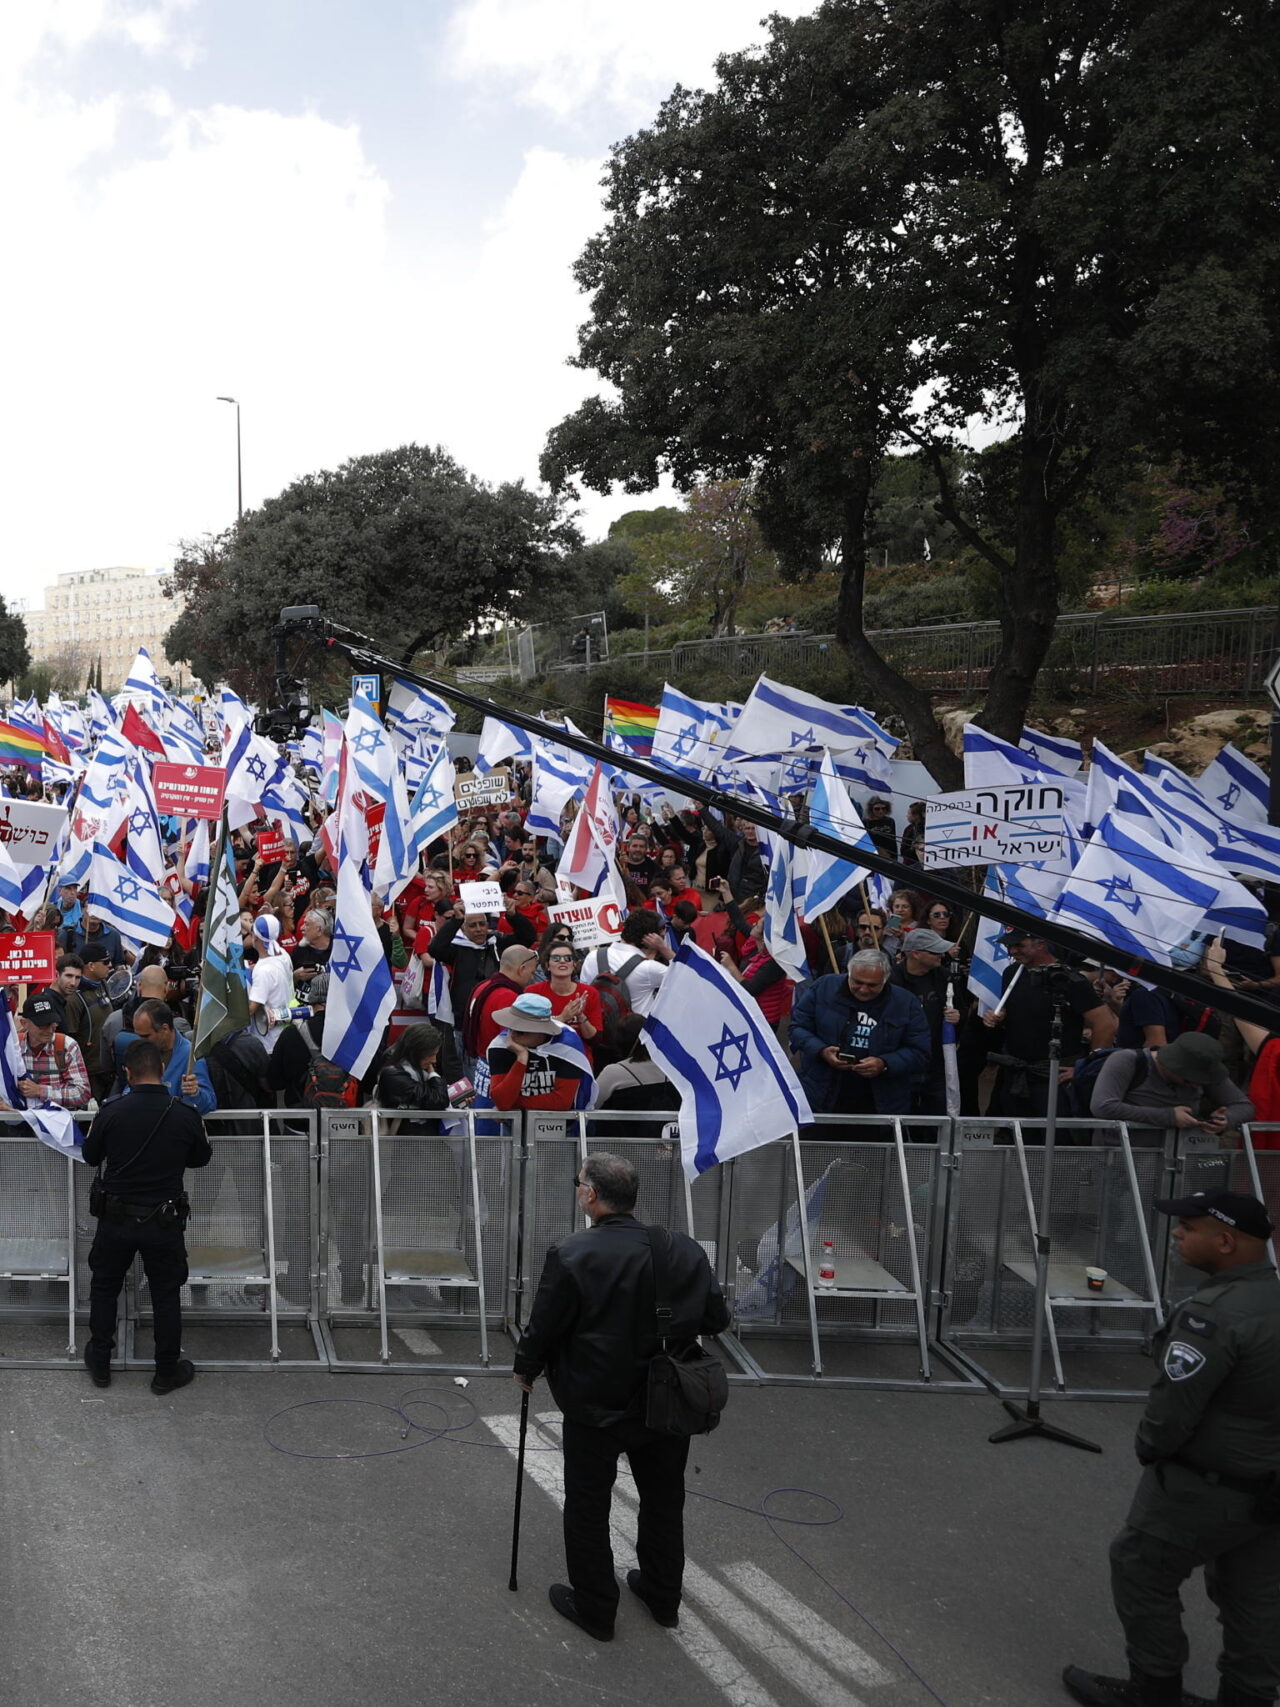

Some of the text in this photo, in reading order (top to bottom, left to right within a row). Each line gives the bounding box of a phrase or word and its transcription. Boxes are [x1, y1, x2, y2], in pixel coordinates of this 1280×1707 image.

[495, 790, 508, 802] לא
[926, 787, 1063, 822] חוקה בהסכמה
[972, 823, 999, 841] או
[925, 839, 1061, 863] ישראל ויהודה
[471, 900, 500, 909] תתפטר
